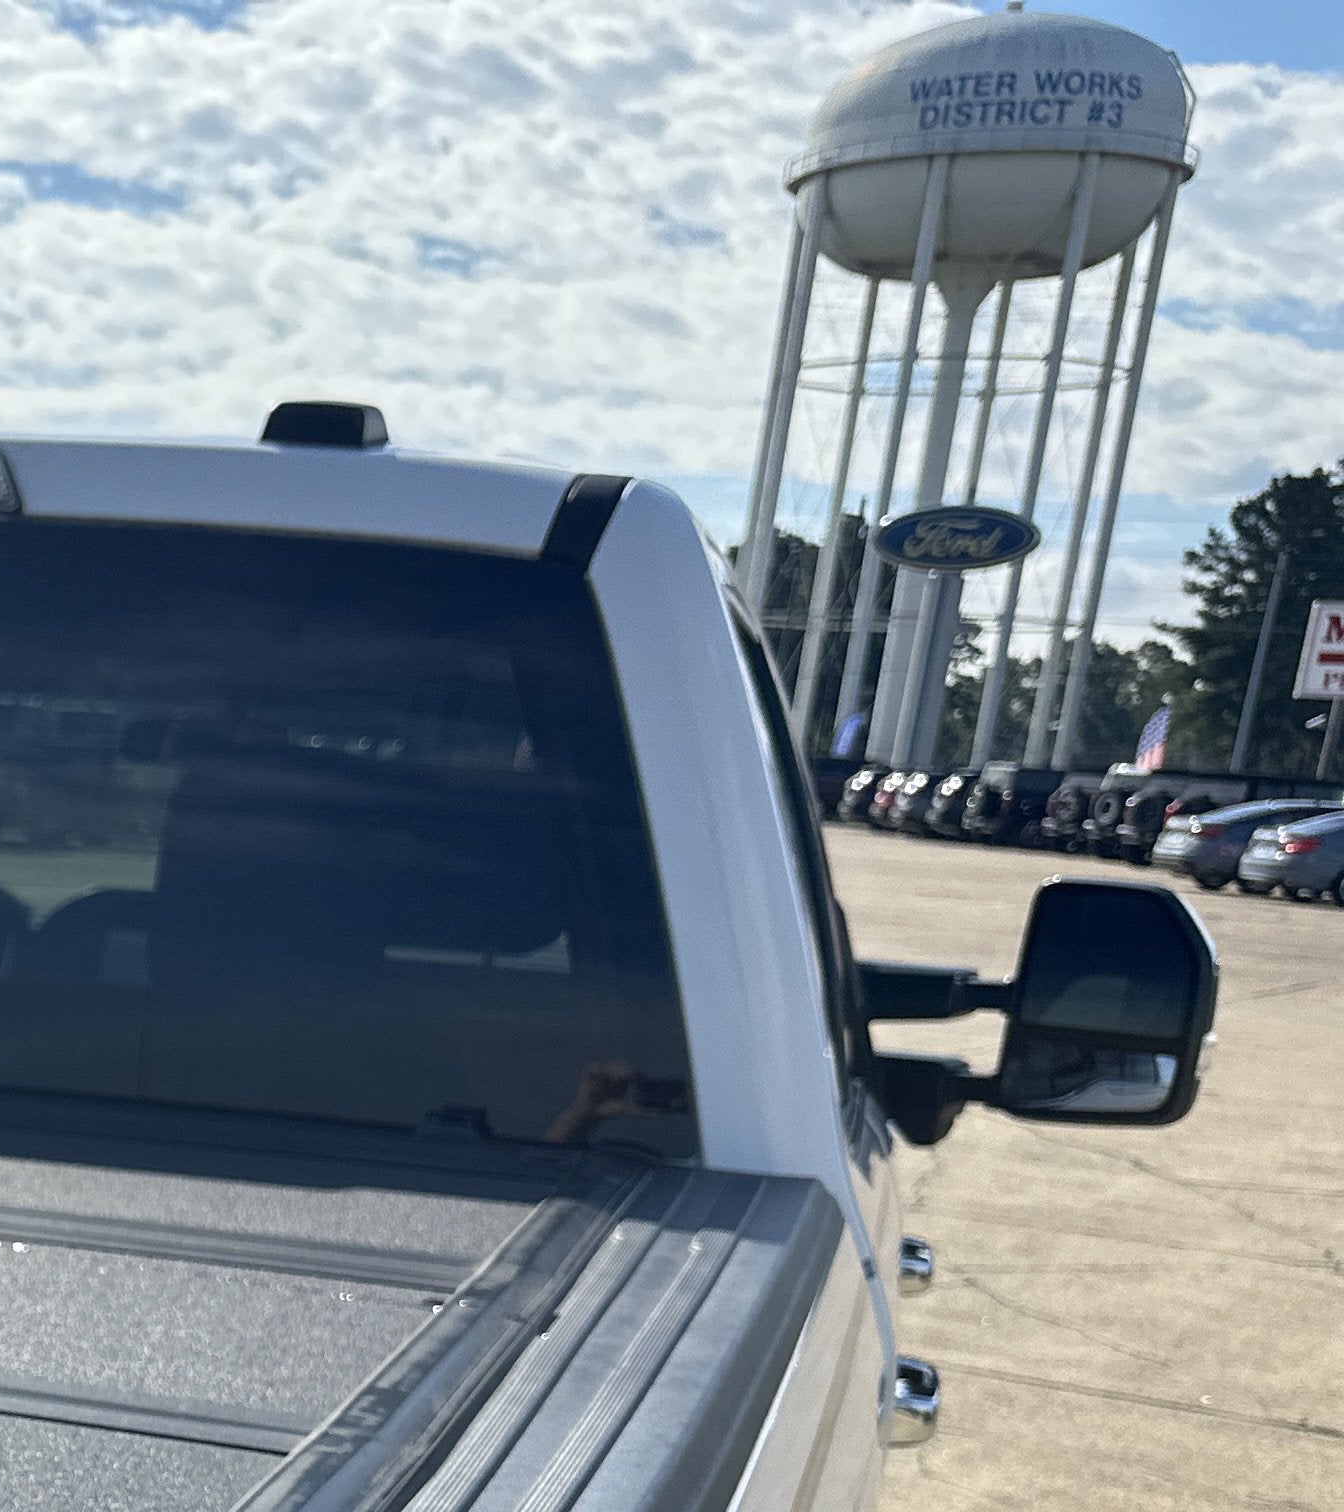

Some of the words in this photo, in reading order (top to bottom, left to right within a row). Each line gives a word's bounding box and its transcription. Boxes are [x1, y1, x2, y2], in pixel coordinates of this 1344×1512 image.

[910, 71, 1017, 102] WATER
[1033, 69, 1143, 100] WORKS
[918, 99, 1073, 130] DISTRICT
[1087, 100, 1124, 129] #3
[902, 517, 1005, 558] Ford
